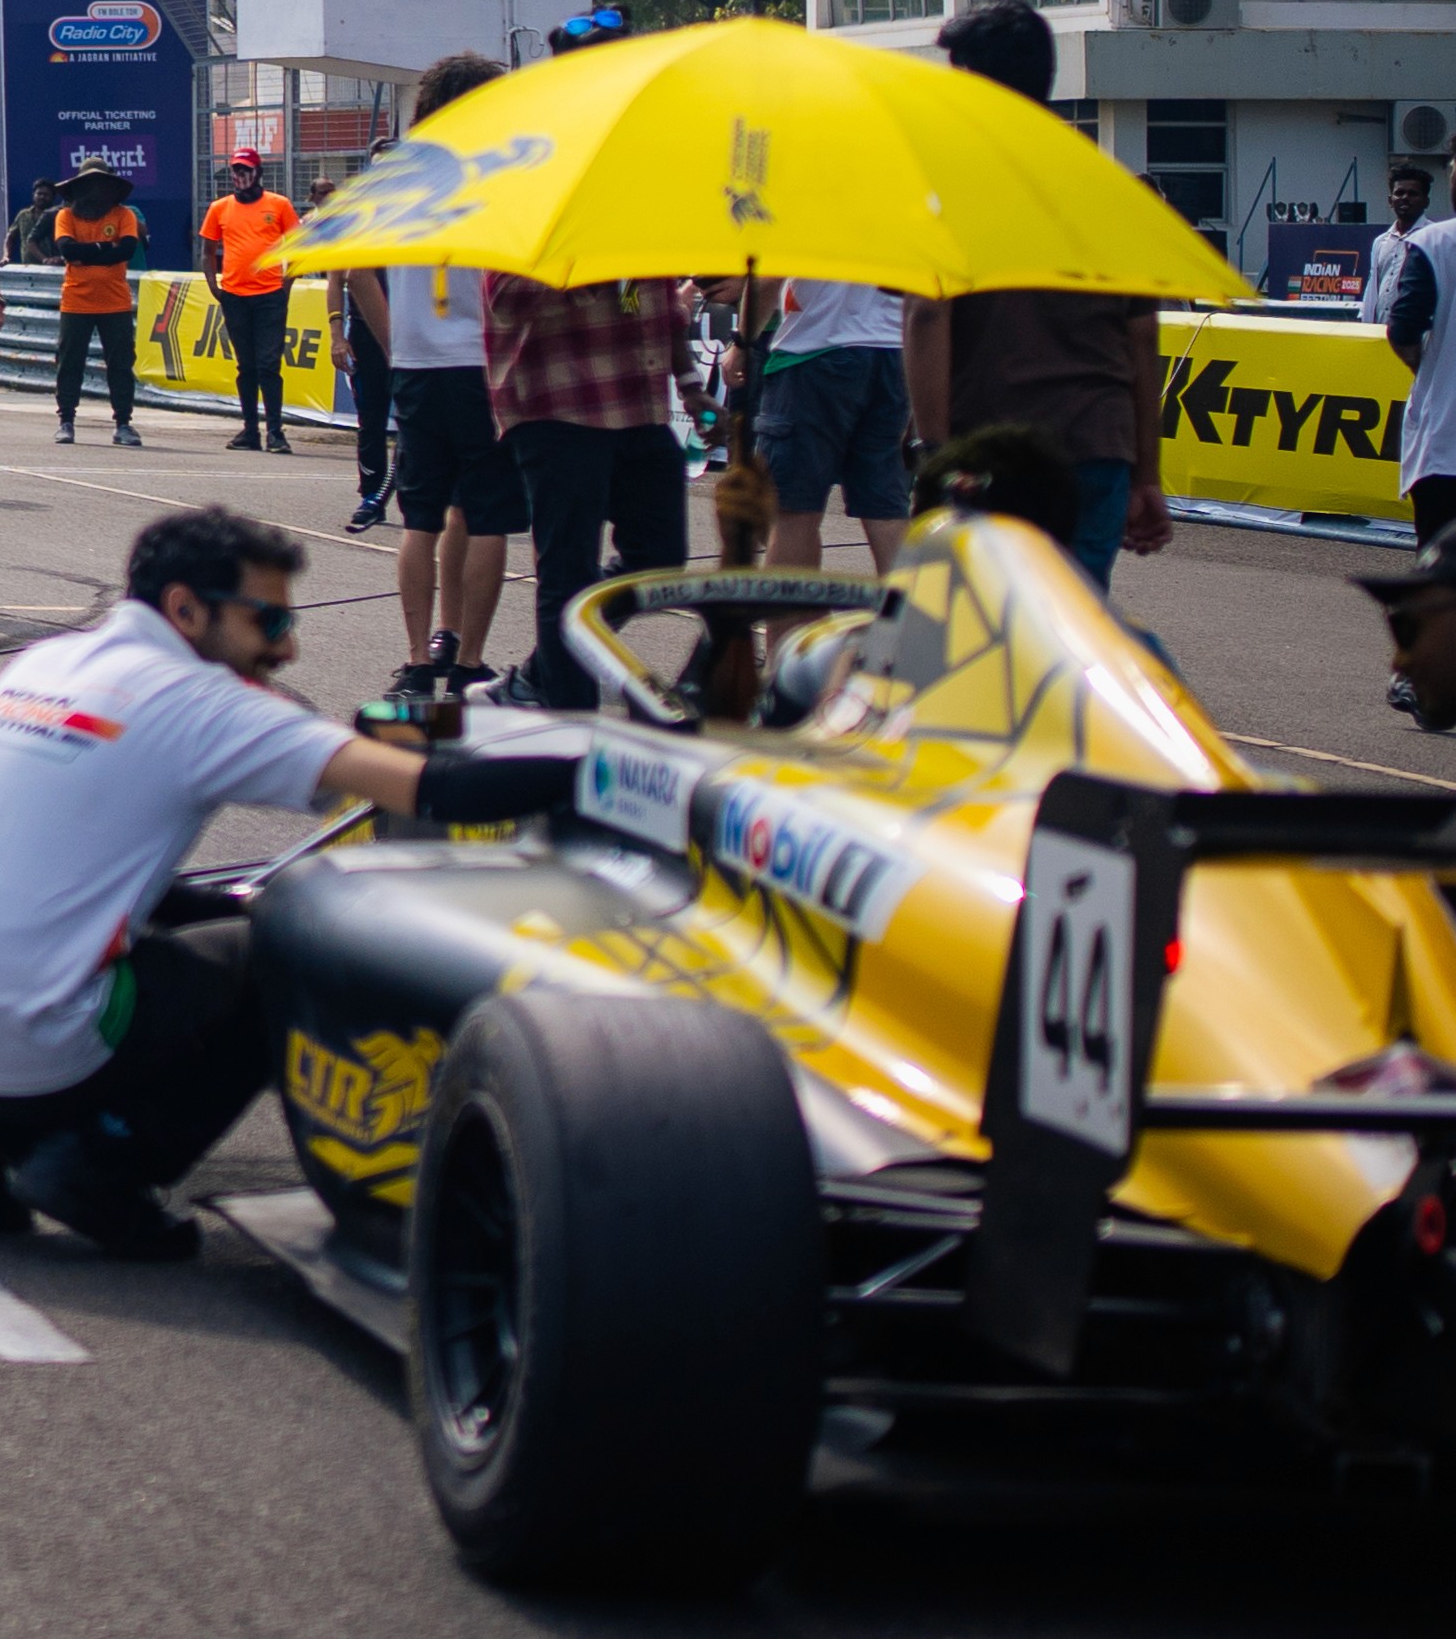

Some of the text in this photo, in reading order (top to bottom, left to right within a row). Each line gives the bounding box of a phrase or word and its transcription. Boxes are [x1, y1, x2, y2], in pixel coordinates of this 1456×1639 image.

[60, 25, 144, 45] Radio City
[69, 52, 157, 62] A JAGRAN INITIATIVE
[58, 111, 156, 120] OFFICIAL TICKETING
[85, 122, 131, 131] PARTNER
[1301, 276, 1361, 293] RACING 2025
[718, 784, 836, 897] Mobil
[1041, 912, 1112, 1095] 44
